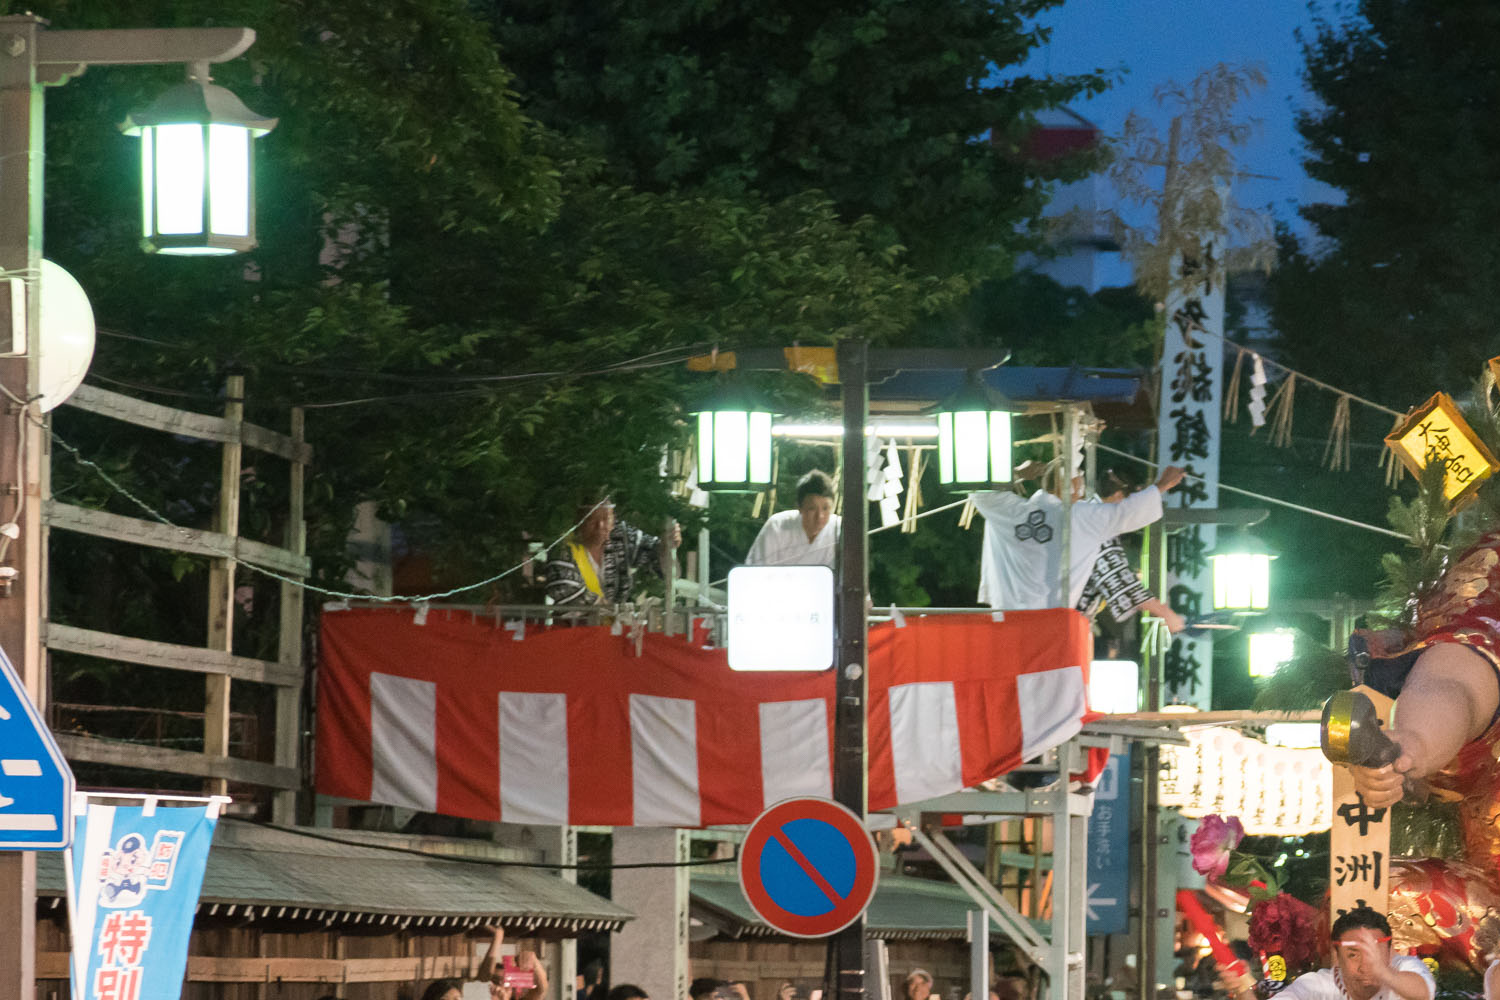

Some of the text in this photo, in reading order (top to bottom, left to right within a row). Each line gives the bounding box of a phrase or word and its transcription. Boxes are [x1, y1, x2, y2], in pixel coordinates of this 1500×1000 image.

[1418, 421, 1474, 483] 大神宮
[1335, 790, 1388, 918] 中洲
